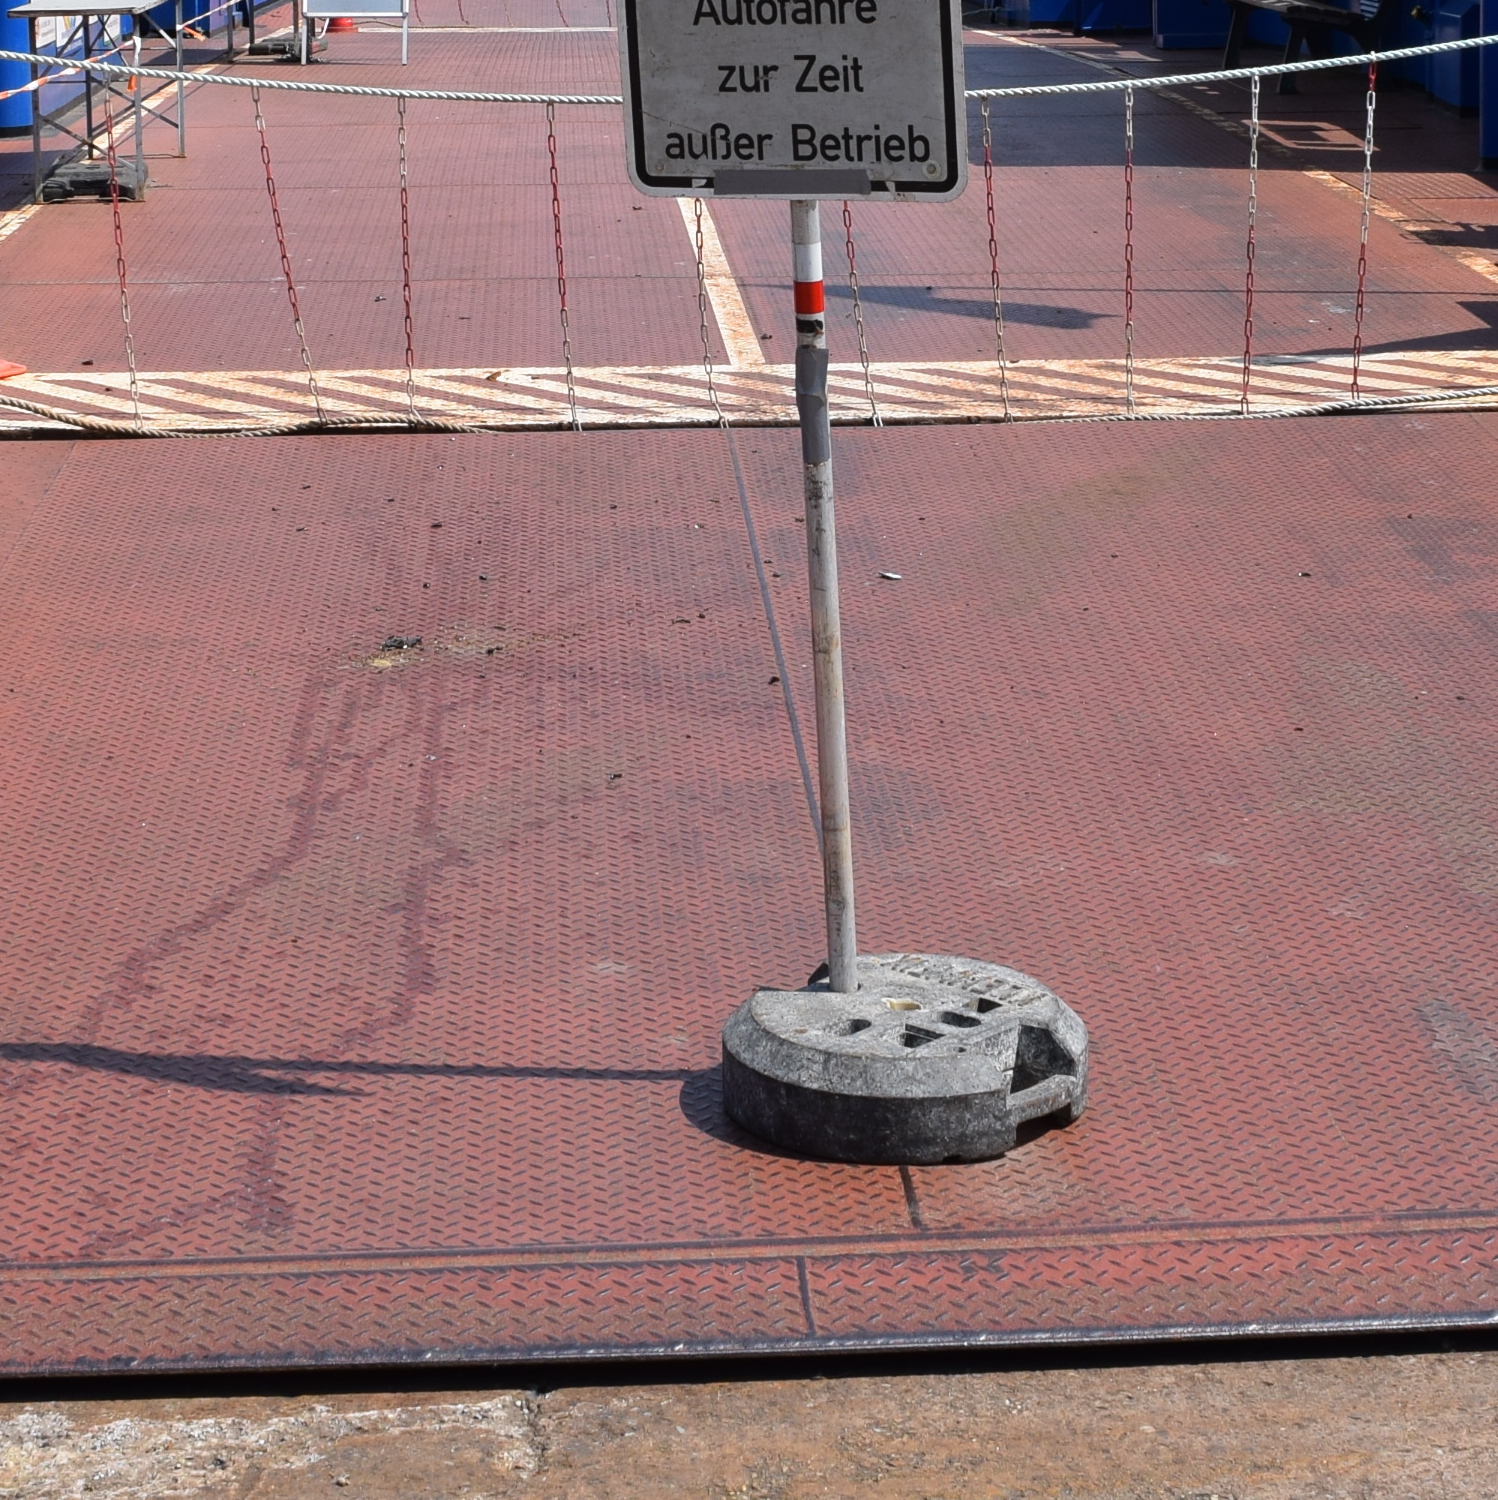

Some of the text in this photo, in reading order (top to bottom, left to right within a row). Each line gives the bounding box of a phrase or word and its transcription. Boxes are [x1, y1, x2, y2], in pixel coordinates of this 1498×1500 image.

[717, 54, 864, 93] zur Zeit
[664, 122, 931, 163] außer Betrieb
